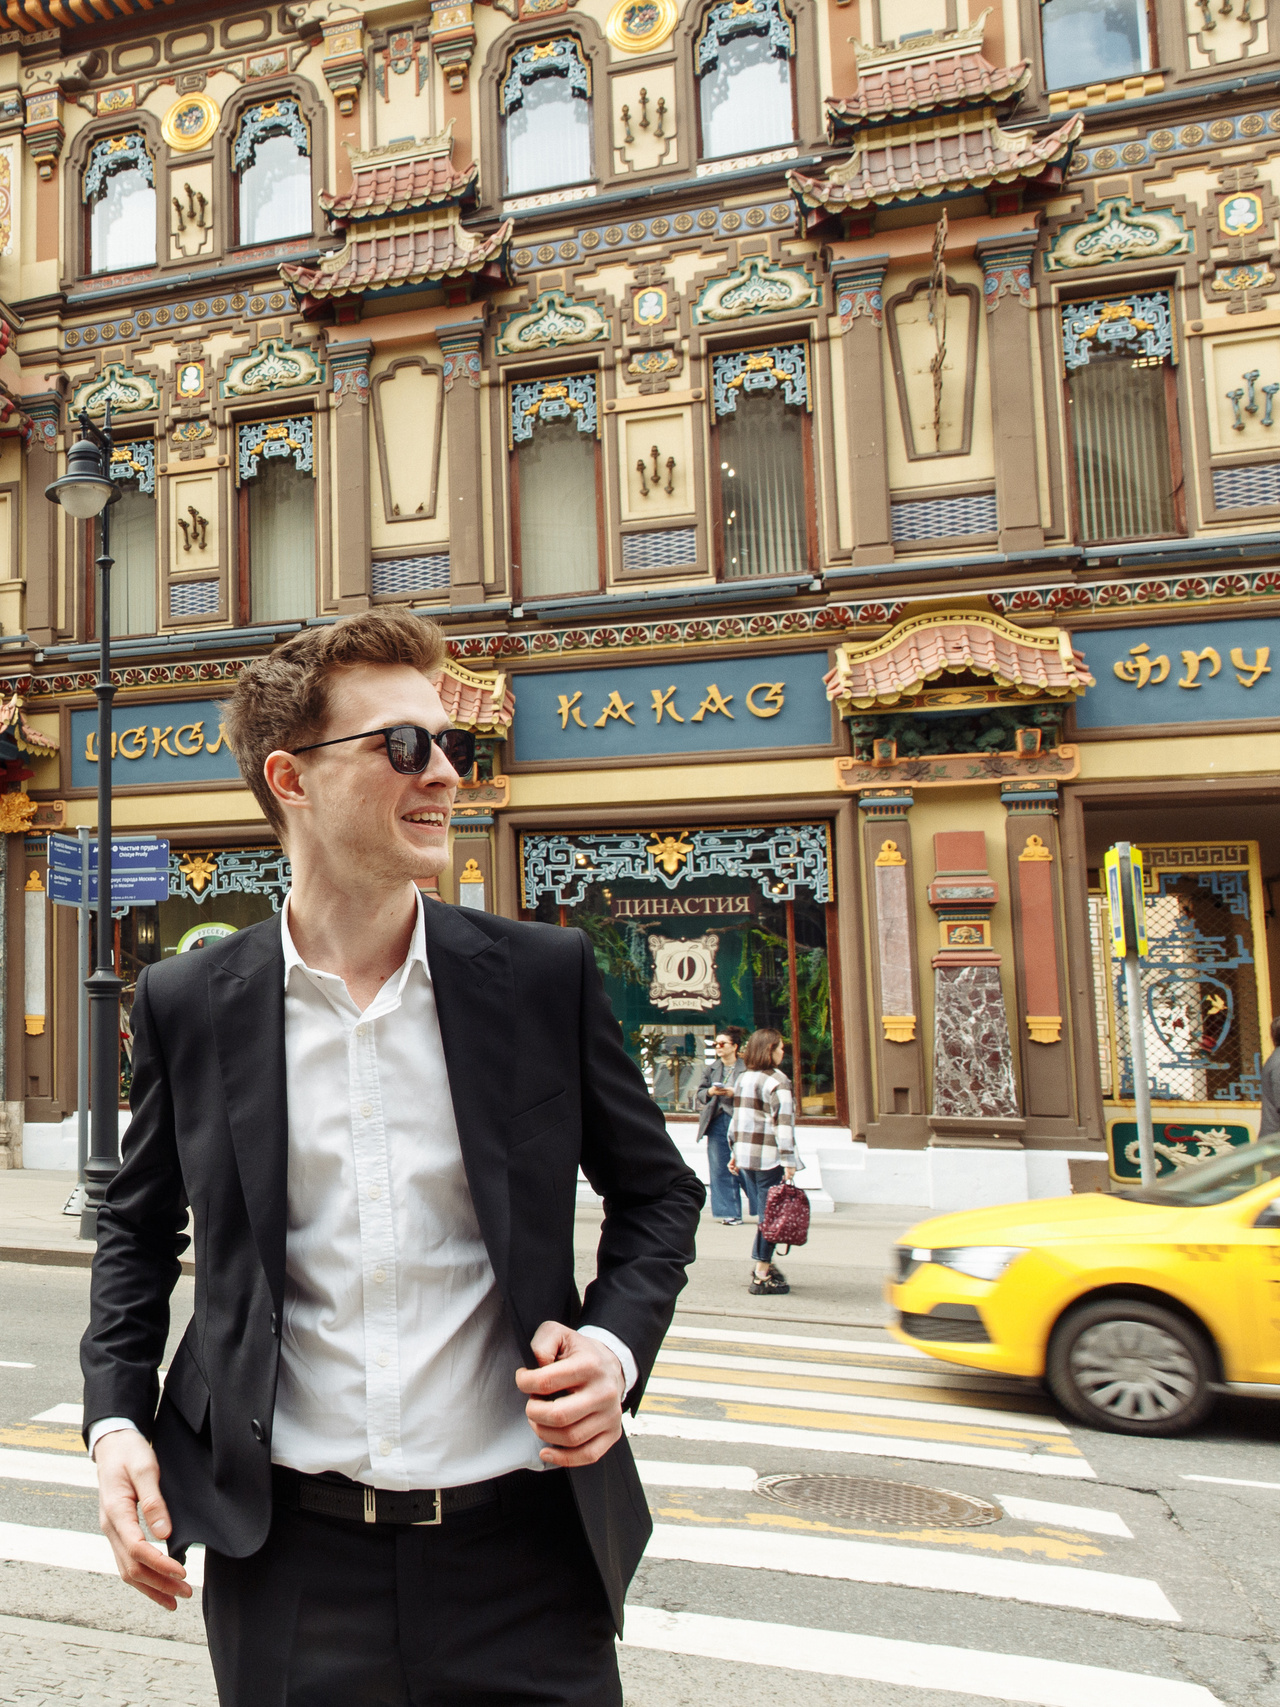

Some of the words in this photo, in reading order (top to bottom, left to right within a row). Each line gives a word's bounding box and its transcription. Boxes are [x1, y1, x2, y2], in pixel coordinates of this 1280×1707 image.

[557, 682, 786, 730] КАКАО
[85, 721, 233, 762] ШОКОЛ
[614, 896, 751, 918] ДИНАСТИЯ
